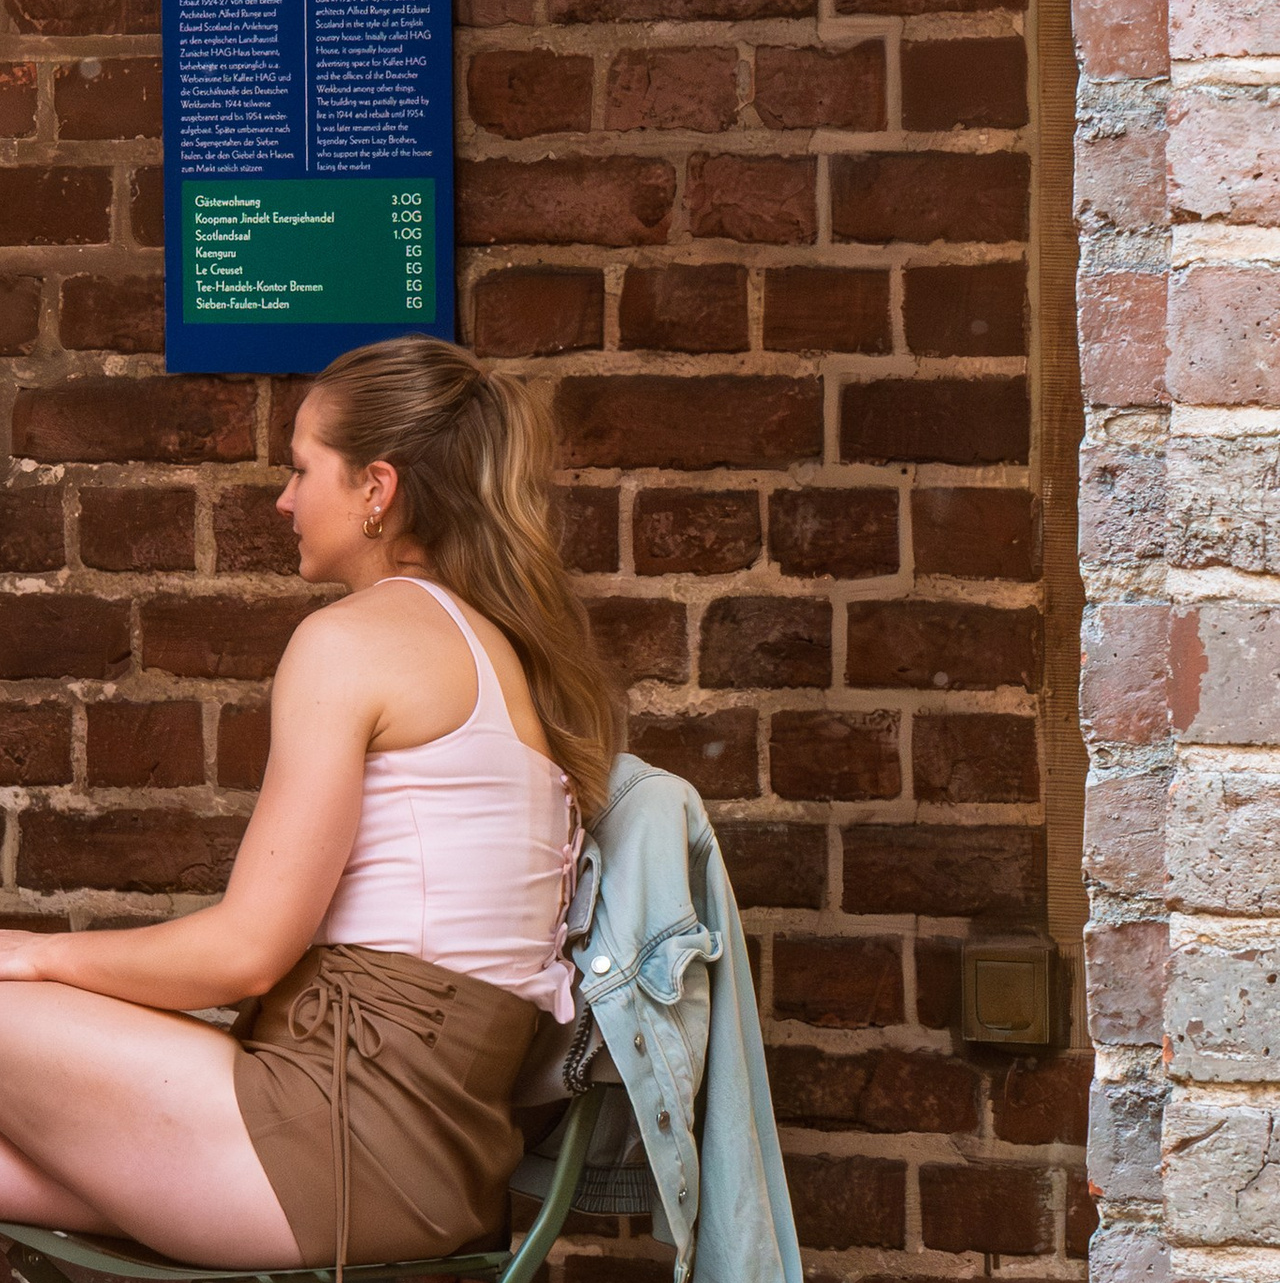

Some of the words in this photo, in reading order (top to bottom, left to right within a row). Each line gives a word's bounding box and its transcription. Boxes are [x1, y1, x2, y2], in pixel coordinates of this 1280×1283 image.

[179, 10, 217, 19] Architekten
[218, 9, 240, 18] Alfred
[263, 9, 277, 17] und
[315, 7, 345, 16] architects
[346, 6, 369, 15] Alfred
[392, 5, 405, 14] and
[406, 4, 430, 14] Eduard
[179, 22, 203, 32] Eduard
[204, 22, 232, 32] Scotland
[315, 19, 344, 29] Scotland
[353, 19, 364, 28] the
[366, 19, 381, 29] style
[382, 18, 389, 27] of
[400, 17, 423, 28] English
[388, 31, 408, 40] called
[410, 29, 432, 40] HAG
[189, 36, 203, 45] den
[378, 44, 403, 53] housed
[372, 58, 381, 66] for
[383, 57, 404, 66] Kaffee
[405, 56, 427, 66] HAG
[233, 73, 254, 82] Kaffee
[255, 72, 276, 82] HAG
[278, 73, 291, 82] und
[316, 71, 329, 80] and
[330, 71, 341, 80] the
[365, 70, 372, 80] of
[373, 71, 384, 79] the
[385, 70, 418, 79] Deutscher
[180, 87, 191, 96] die
[240, 86, 253, 95] des
[254, 85, 288, 95] Deutschen
[316, 84, 351, 94] Werkbund
[225, 99, 242, 108] 1944
[316, 97, 329, 107] The
[330, 97, 357, 108] building
[420, 95, 429, 106] by
[220, 112, 233, 121] und
[234, 113, 244, 121] bis
[336, 110, 353, 119] 1944
[355, 110, 368, 118] and
[369, 109, 390, 118] rebuilt
[215, 124, 236, 135] Später
[275, 124, 290, 133] nach
[337, 123, 351, 132] later
[397, 122, 409, 131] the
[180, 138, 194, 147] den
[243, 138, 254, 146] der
[256, 137, 279, 146] Sieben
[349, 135, 370, 145] Seven
[371, 136, 387, 145] Lazy
[205, 151, 216, 160] die
[217, 151, 230, 160] den
[231, 150, 255, 159] Giebel
[256, 150, 269, 159] des
[270, 150, 294, 159] Hauses
[317, 149, 332, 157] who
[333, 151, 358, 159] support
[359, 149, 370, 157] the
[372, 148, 390, 158] gable
[391, 148, 398, 157] of
[400, 149, 411, 157] the
[412, 148, 432, 157] house
[317, 161, 336, 172] facing
[337, 162, 348, 171] the
[195, 195, 260, 208] Gästewohnung
[392, 193, 421, 205] 3.OG
[195, 213, 238, 226] Koopman
[240, 212, 270, 224] Jindelt
[273, 212, 334, 225] Energiehandel
[392, 210, 422, 222] 2.OG
[196, 230, 250, 241] Scotlandsaal
[394, 228, 422, 240] 1.OG
[196, 246, 236, 260] Kaenguru
[406, 245, 422, 256] EG
[196, 264, 207, 275] Le
[210, 263, 242, 275] Creuset
[406, 262, 422, 274] EG
[196, 281, 287, 292] Tee-Handels-Kontor
[290, 280, 323, 292] Bremen
[406, 280, 422, 291] EG
[196, 297, 289, 309] Sieben-Faulen-Laden
[406, 297, 422, 308] EG
